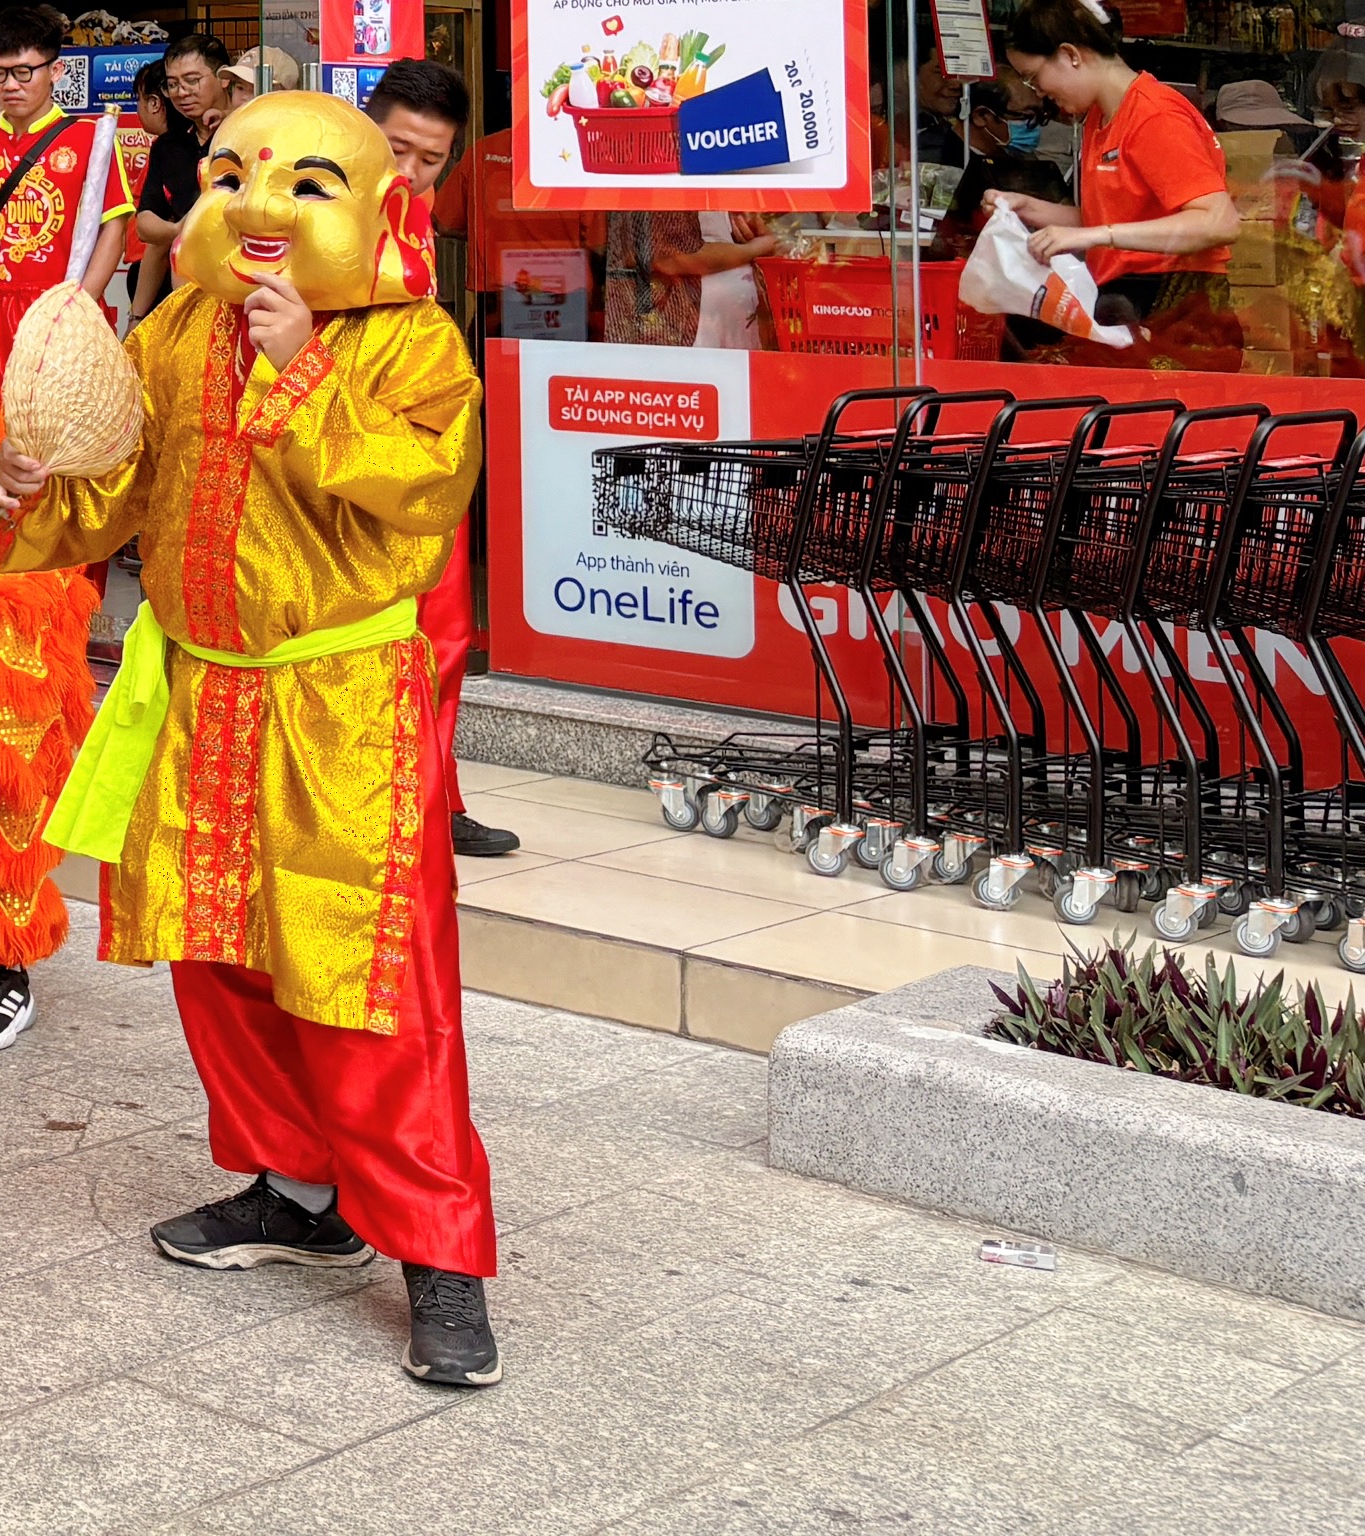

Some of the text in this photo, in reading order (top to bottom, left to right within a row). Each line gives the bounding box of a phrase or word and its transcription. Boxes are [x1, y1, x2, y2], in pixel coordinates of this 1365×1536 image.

[687, 120, 778, 151] VOUCHER
[564, 385, 588, 402] TẢI
[593, 390, 625, 403] APP
[629, 392, 673, 407] NGAY
[561, 404, 704, 432] SỬ DỤNG DỊCH VỤ
[576, 551, 690, 578] App thành viên
[554, 577, 719, 630] OneLife
